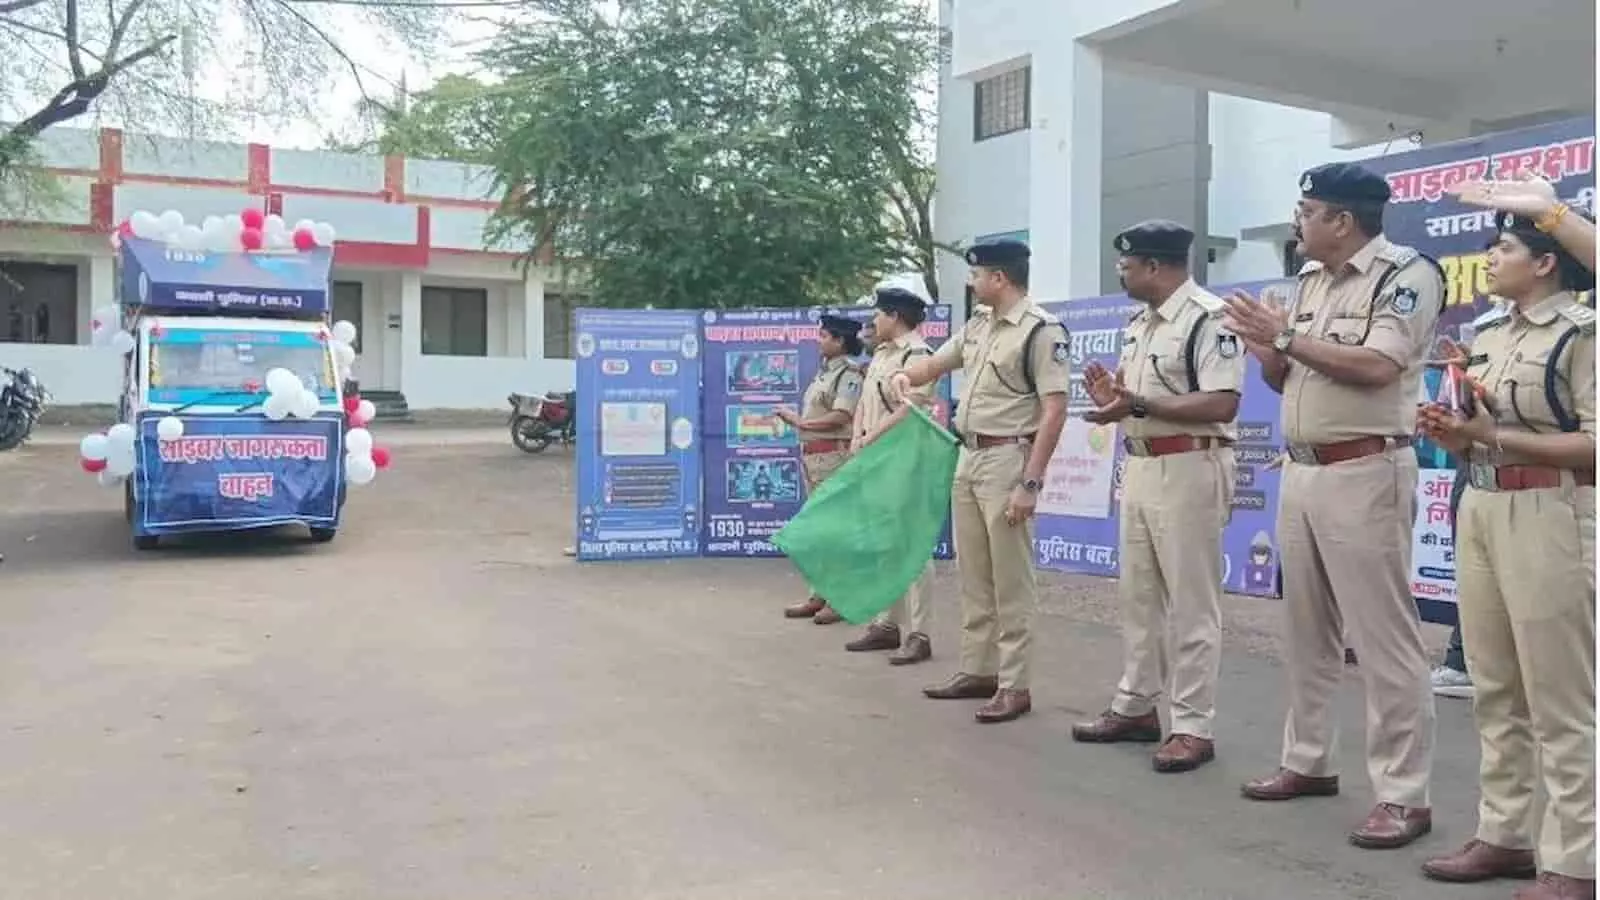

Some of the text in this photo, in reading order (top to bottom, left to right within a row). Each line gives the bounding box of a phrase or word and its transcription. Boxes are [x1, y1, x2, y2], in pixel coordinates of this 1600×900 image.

[224, 434, 328, 461] जागरूकता
[217, 472, 274, 502] वाहन
[708, 520, 744, 537] 1930
[1039, 536, 1083, 564] पुलिस
